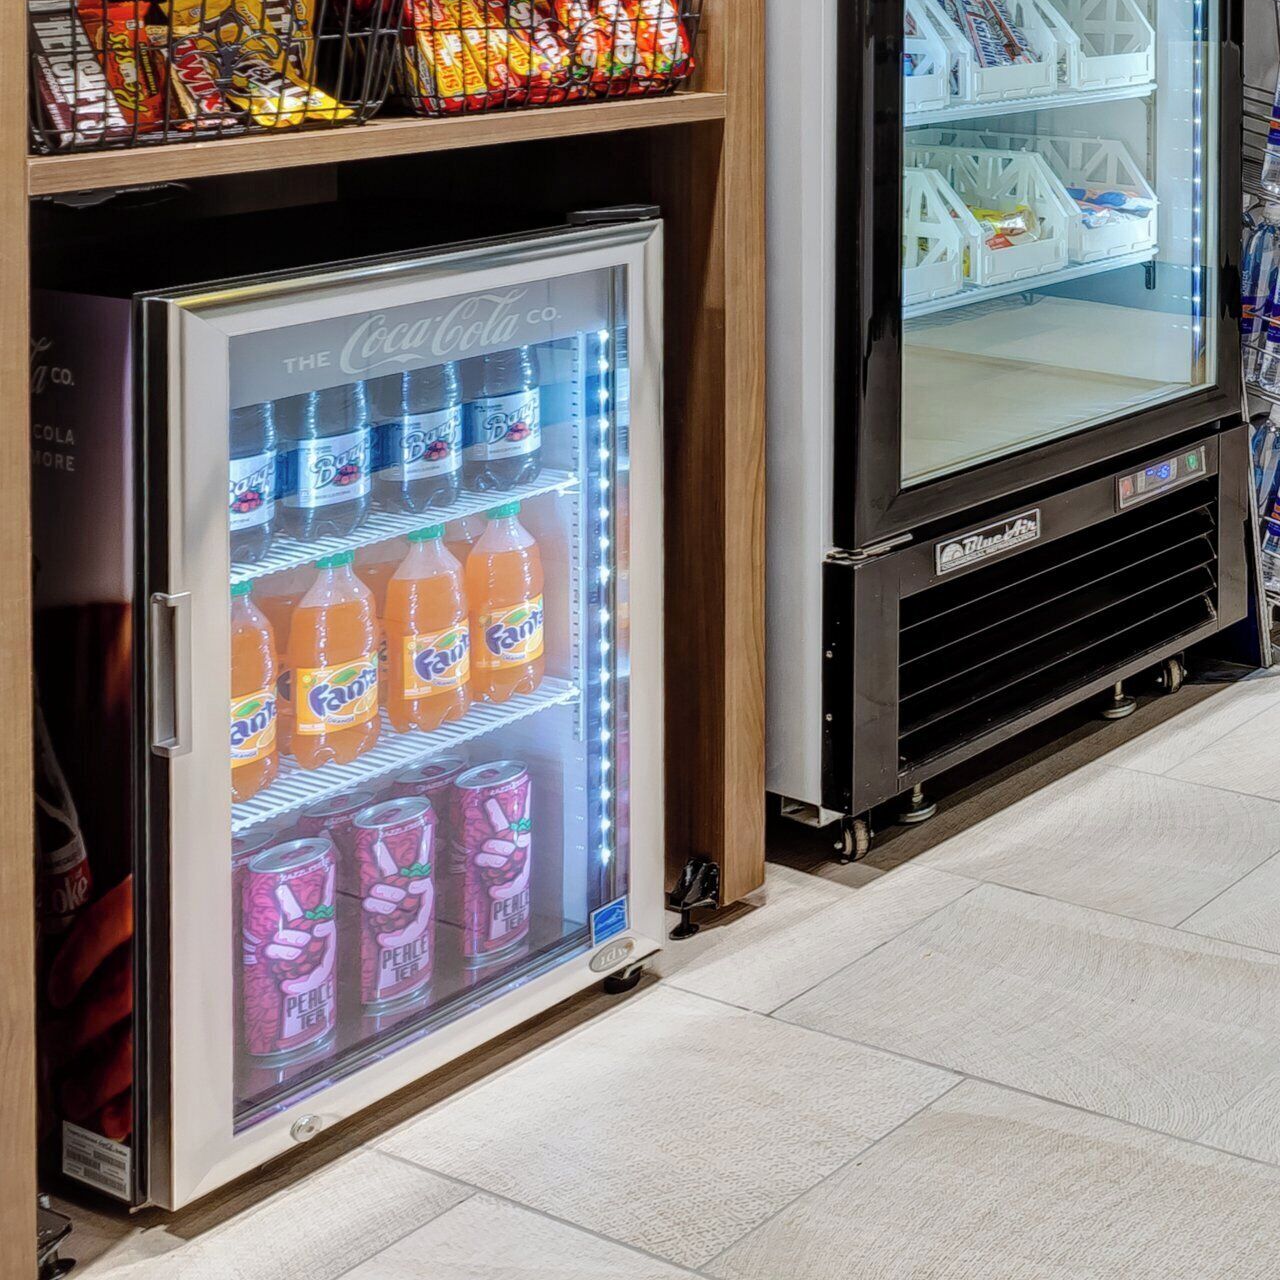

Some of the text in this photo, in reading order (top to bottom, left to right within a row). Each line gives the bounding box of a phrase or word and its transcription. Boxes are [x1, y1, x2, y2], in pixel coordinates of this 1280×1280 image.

[283, 287, 563, 375] THE Coca-Cola CO.
[50, 366, 75, 387] CO.
[961, 518, 1038, 556] Blue Air
[307, 665, 378, 718] Fanta
[230, 698, 278, 747] anta
[501, 910, 526, 930] TEA
[381, 933, 430, 973] PEACE
[394, 962, 421, 985] TEA
[286, 980, 335, 1020] PEACE
[301, 1005, 326, 1031] TEA
